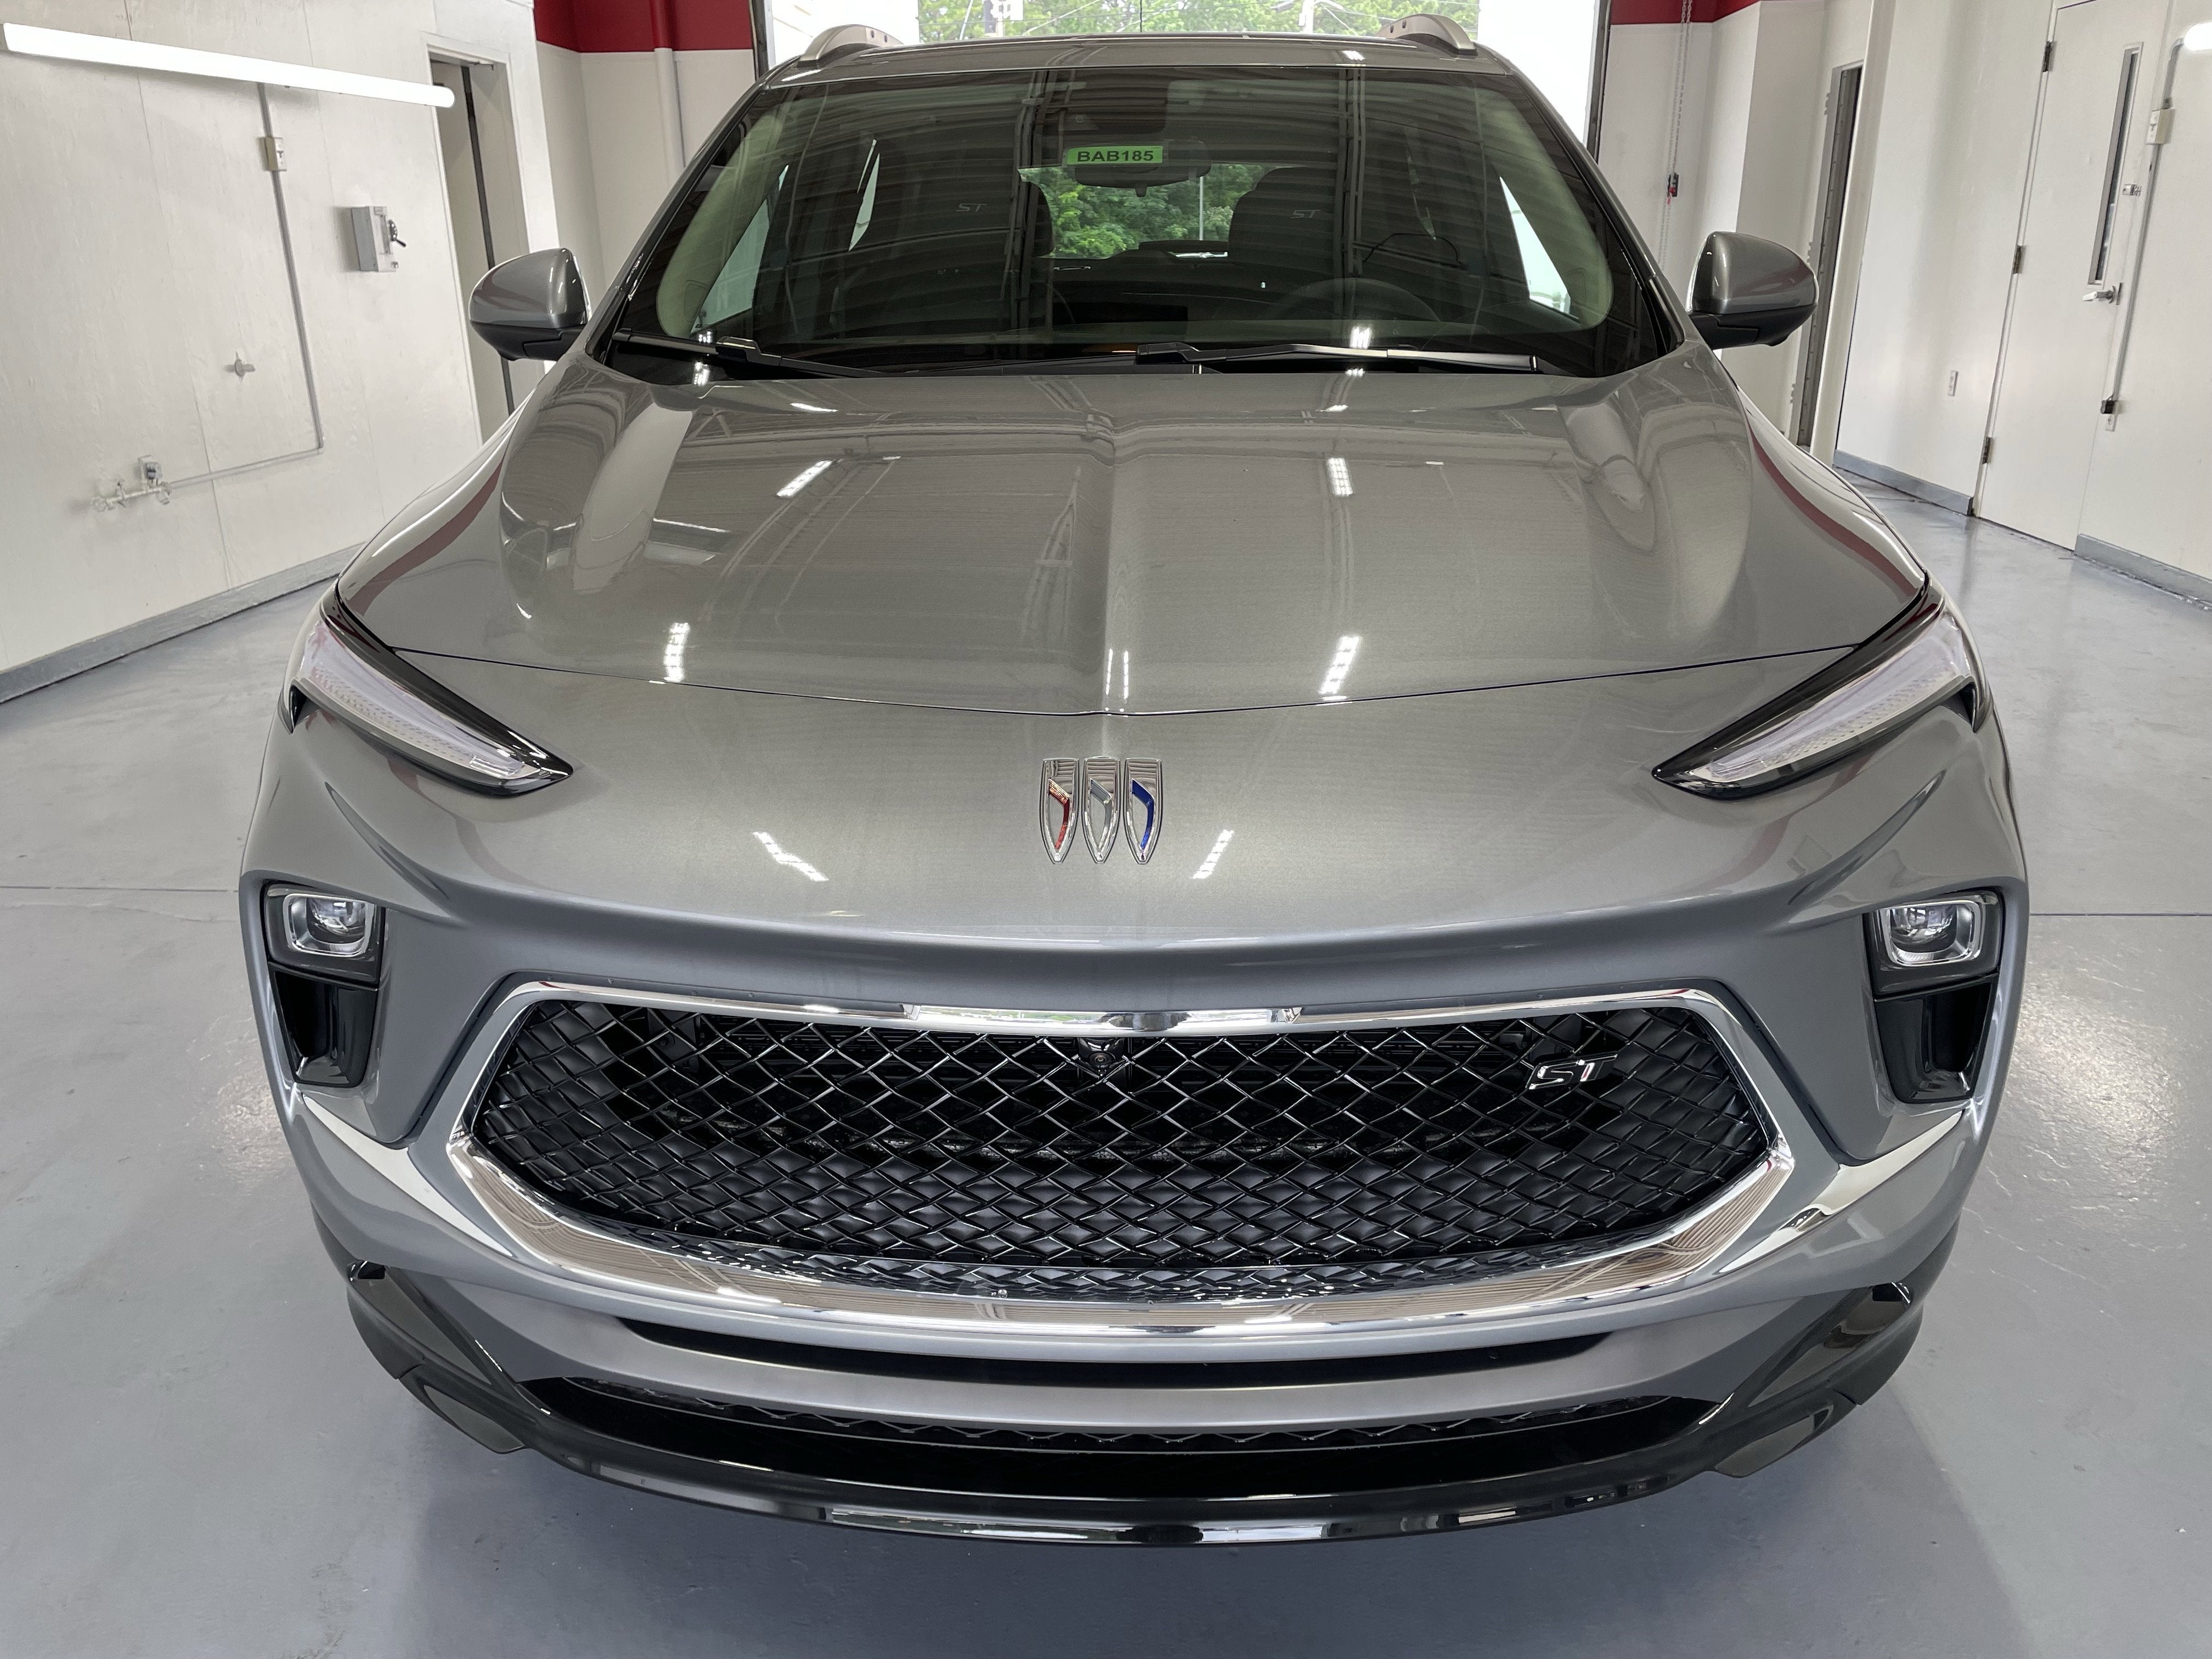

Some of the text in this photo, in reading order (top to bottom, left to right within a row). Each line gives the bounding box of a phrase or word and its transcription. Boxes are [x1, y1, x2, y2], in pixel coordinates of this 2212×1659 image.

[1077, 150, 1154, 162] BAB185
[956, 204, 988, 212] ST
[1290, 210, 1322, 218] ST
[1528, 1053, 1618, 1090] ST
